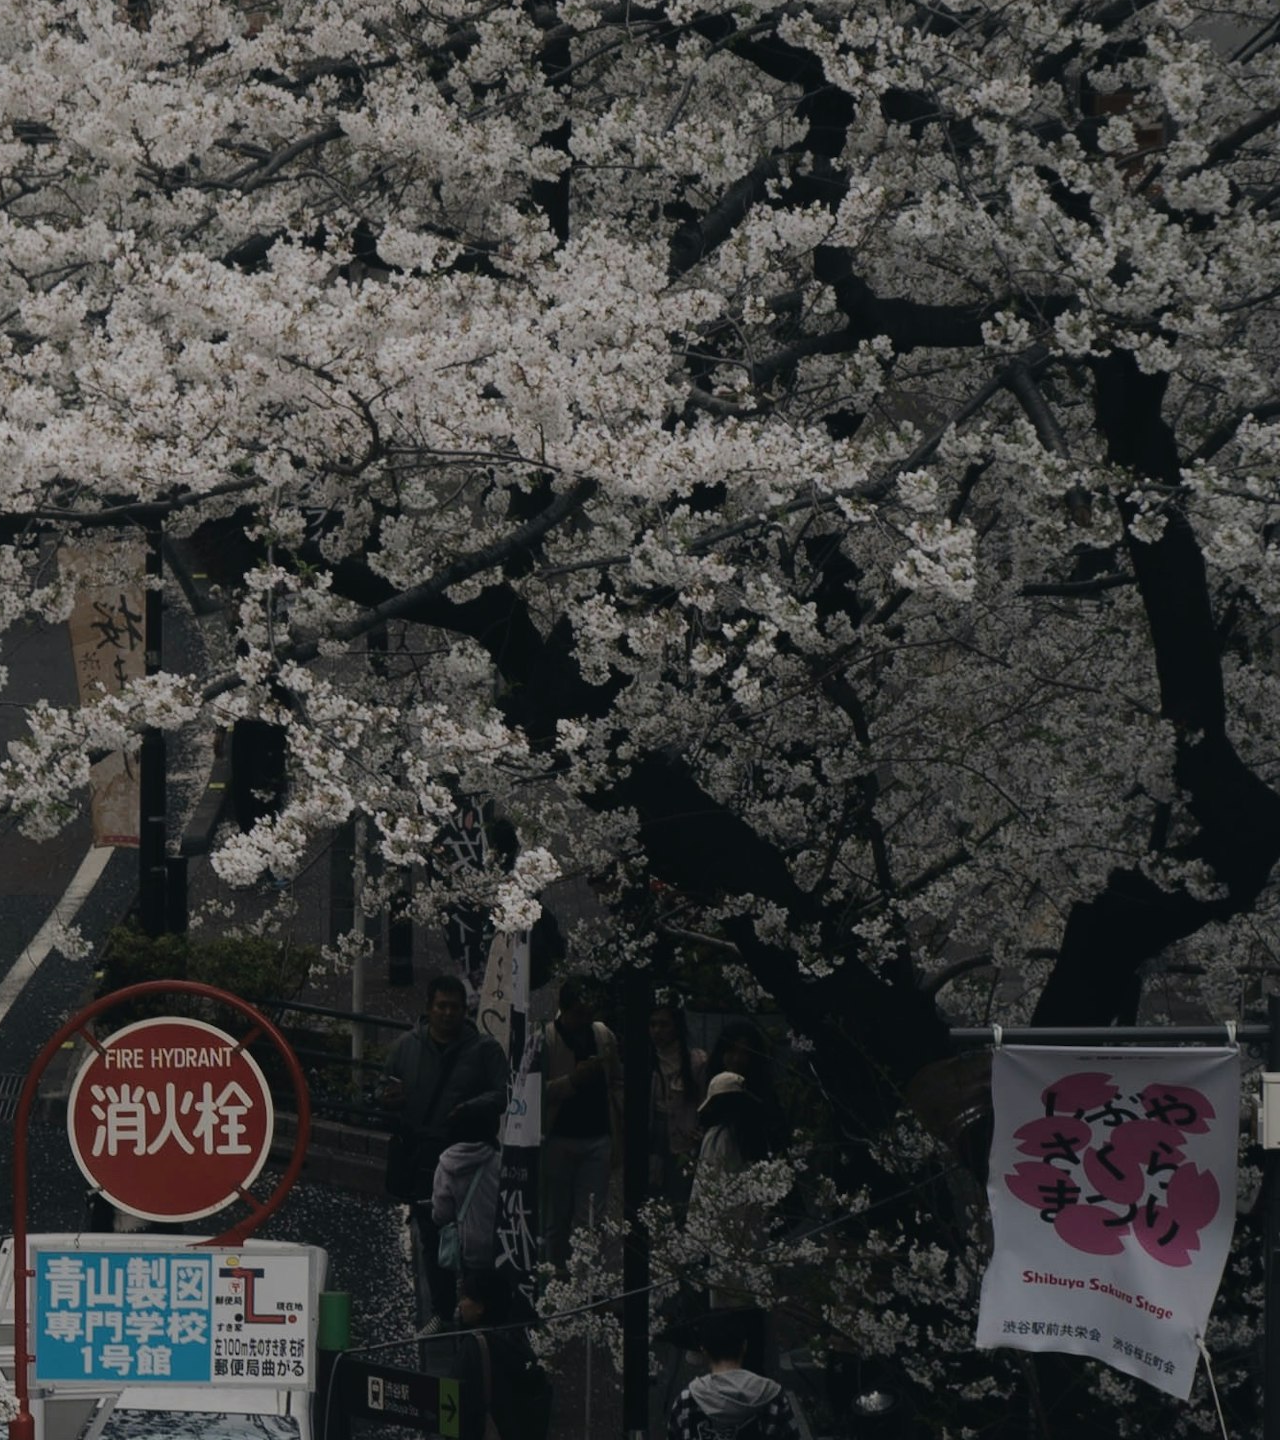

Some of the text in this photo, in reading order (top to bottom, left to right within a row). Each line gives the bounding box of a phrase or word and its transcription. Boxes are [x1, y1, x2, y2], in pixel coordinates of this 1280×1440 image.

[104, 1046, 233, 1070] FIRE HYDRANT
[90, 1081, 254, 1157] 消火栓
[1040, 1132, 1180, 1190] さくら
[1038, 1179, 1180, 1246] まつり
[44, 1256, 210, 1311] 青山製図
[1022, 1270, 1174, 1321] Shibuya Sakura Stage
[44, 1310, 209, 1345] 専門学校
[1002, 1319, 1102, 1343] 渋谷駅前共栄会
[80, 1344, 173, 1377] 1号館
[214, 1358, 305, 1378] 郵便局曲がる
